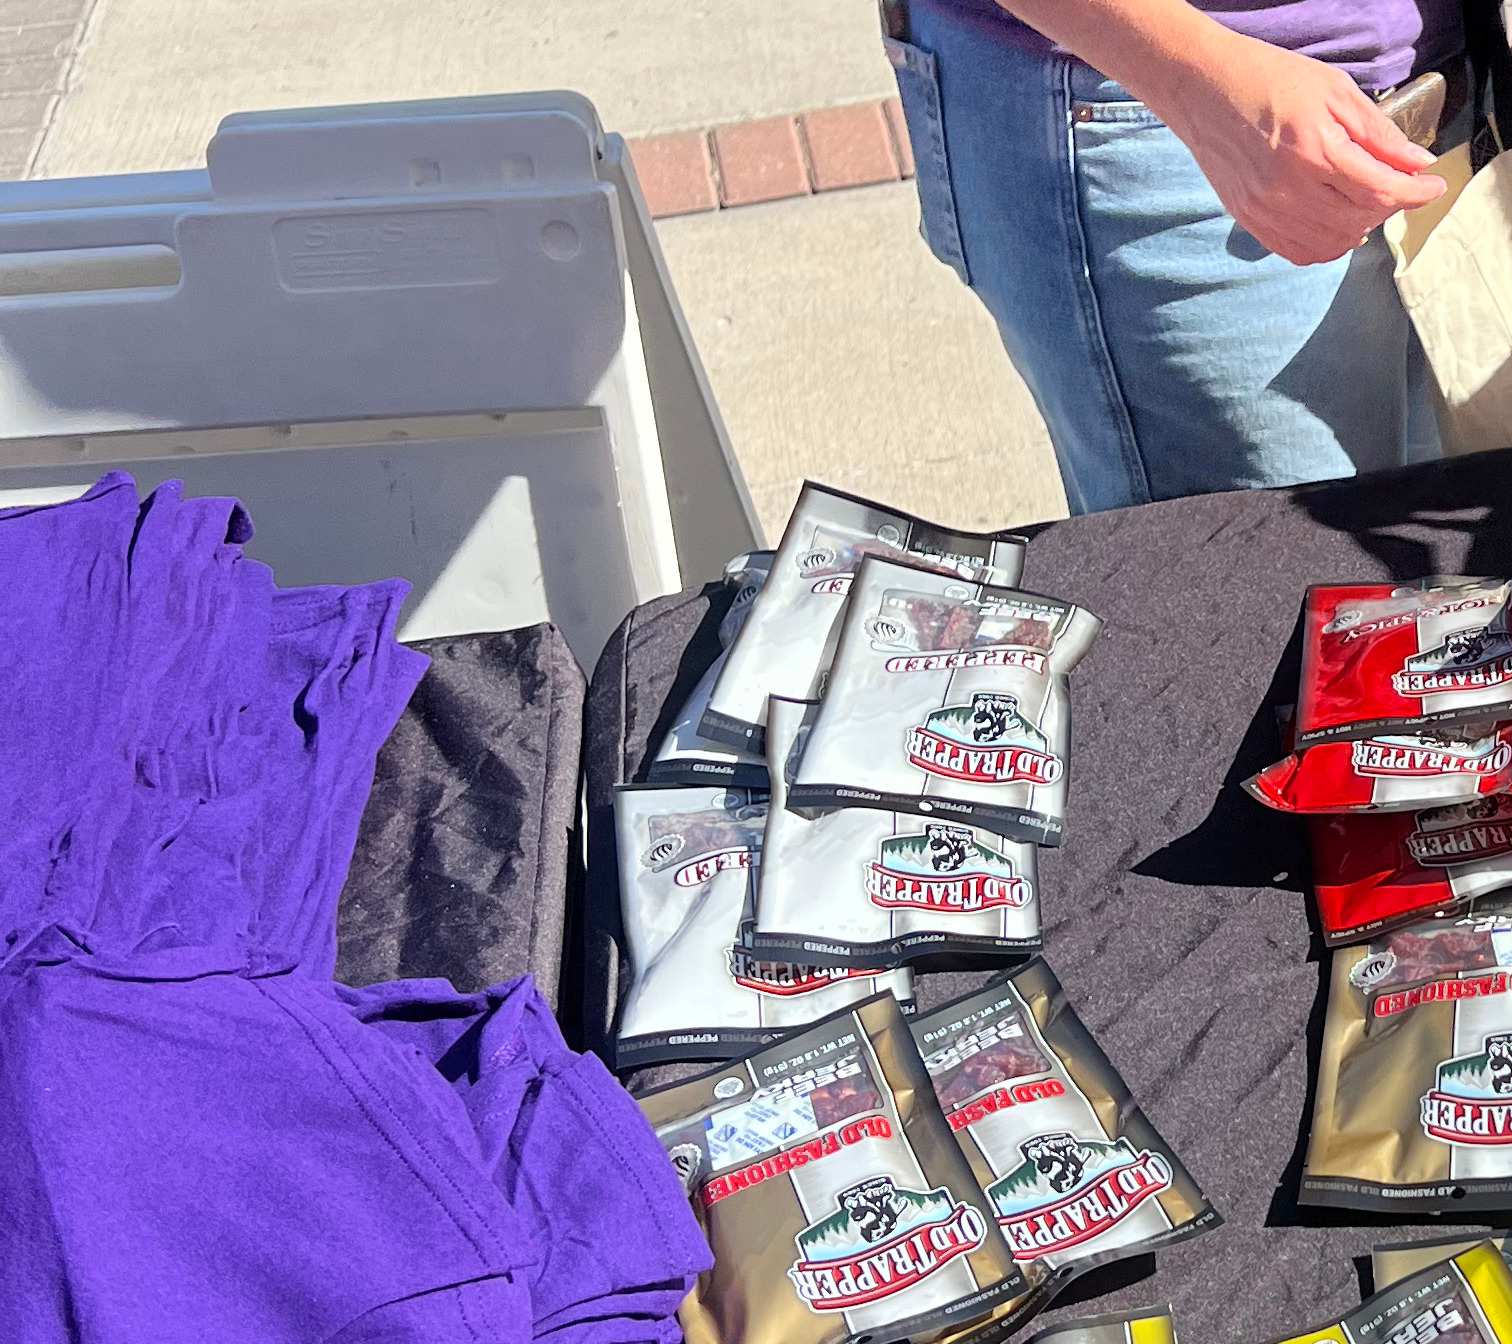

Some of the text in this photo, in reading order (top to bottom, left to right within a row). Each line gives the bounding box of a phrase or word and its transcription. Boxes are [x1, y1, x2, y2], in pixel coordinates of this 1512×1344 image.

[885, 648, 1048, 675] PEPPERED
[1391, 664, 1502, 694] TRAPPER
[905, 729, 1061, 781] OLD TRAPPER
[1351, 741, 1510, 772] OLD TRAPPER
[836, 788, 881, 801] PEPPERED
[927, 800, 973, 814] PEPPERE
[864, 864, 1029, 909] OLD TRAPPER
[803, 941, 850, 956] PEPPERED
[1373, 972, 1508, 1018] FASHIONED
[668, 1034, 719, 1044] PEPPERED
[1008, 1078, 1066, 1101] OLD
[702, 1115, 892, 1205] OLD FASHIONE
[1118, 1157, 1170, 1190] OLD
[1381, 1187, 1435, 1197] FASHIONED
[792, 1205, 984, 1301] OLD TRAPPER
